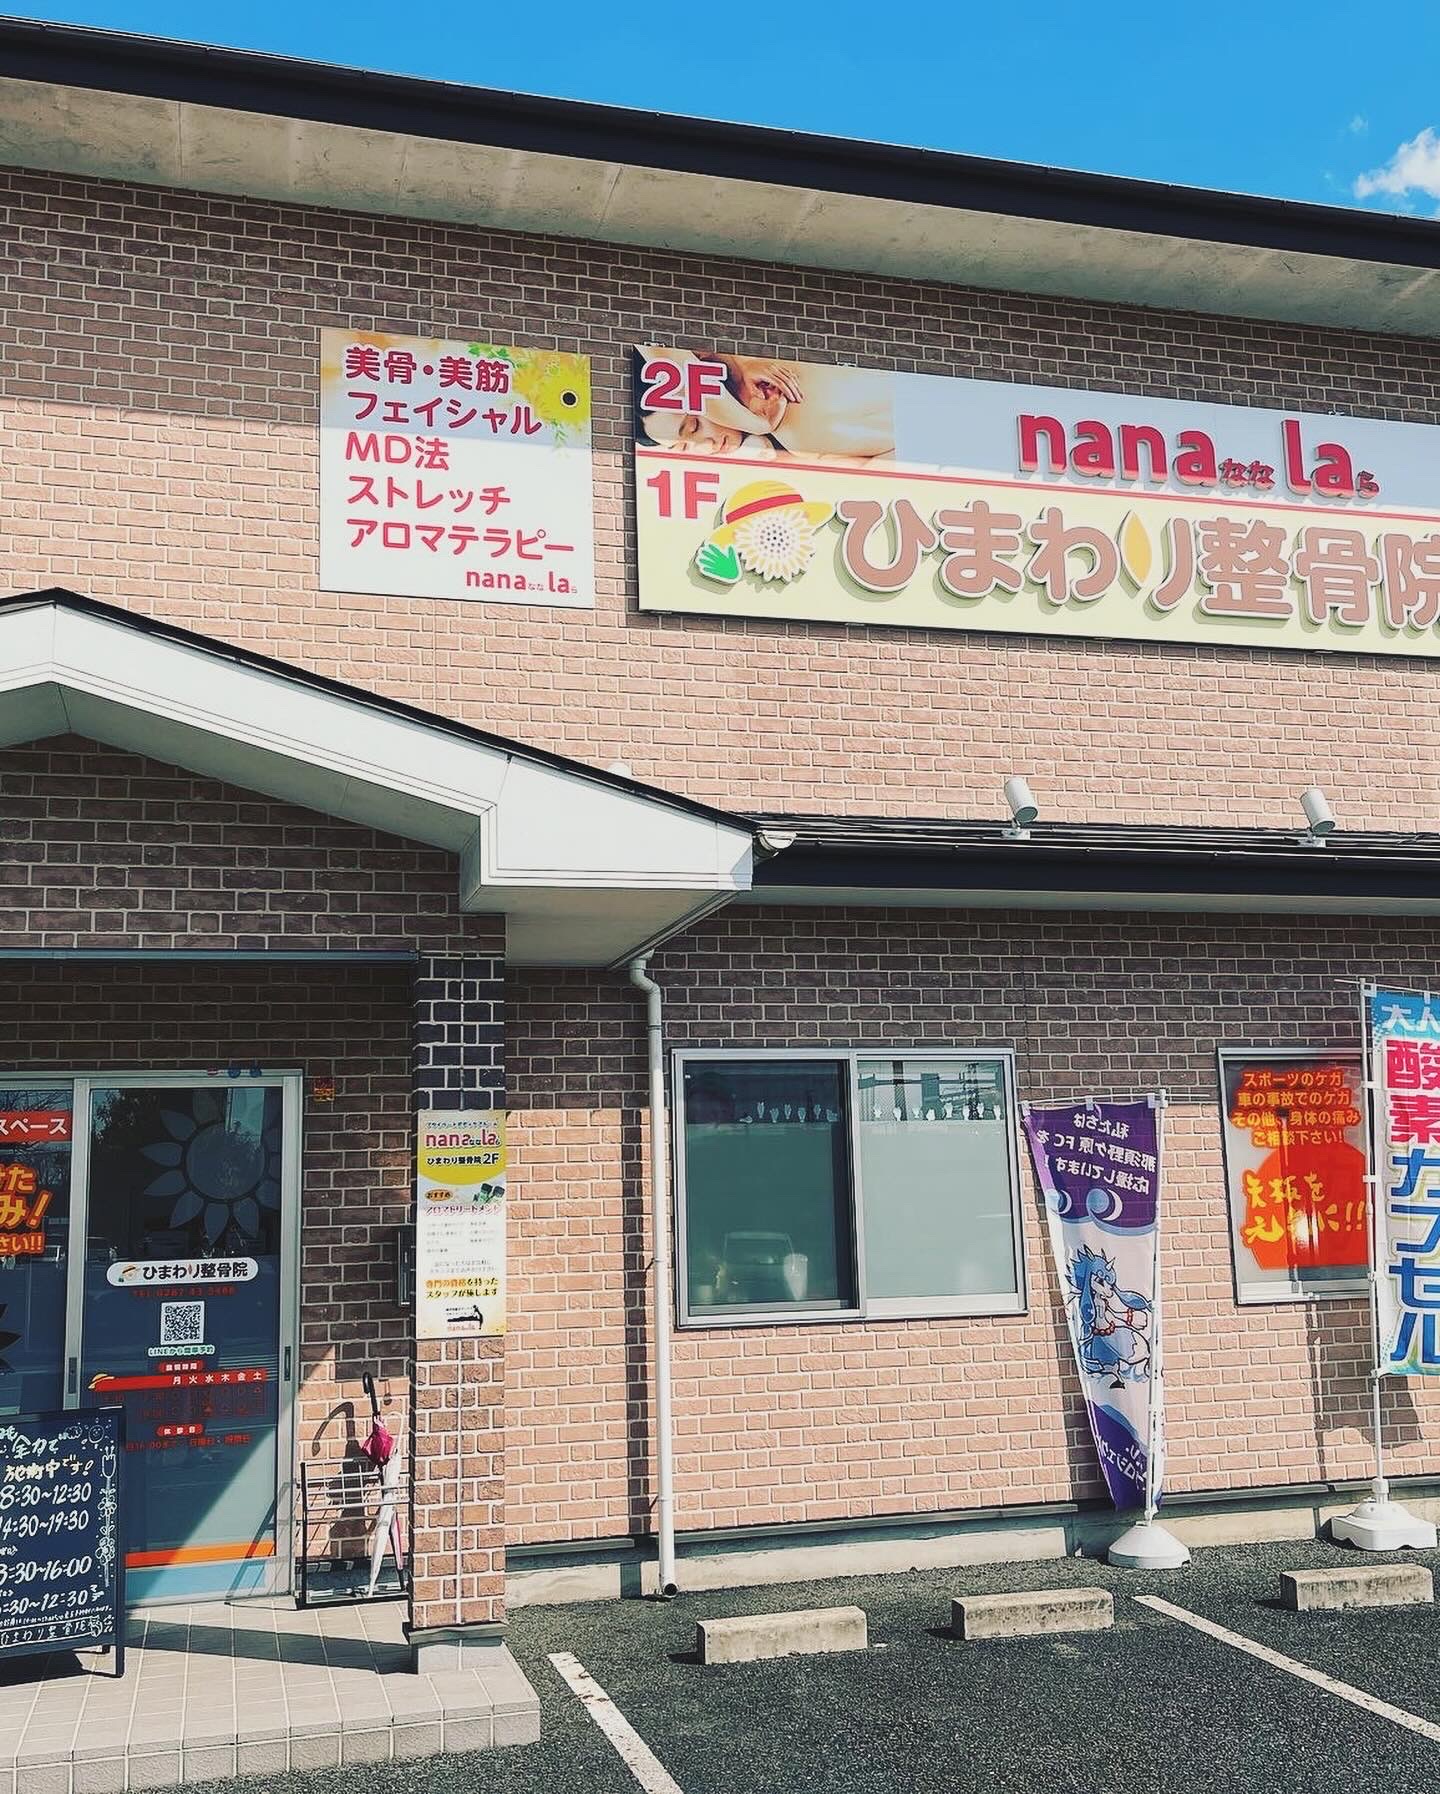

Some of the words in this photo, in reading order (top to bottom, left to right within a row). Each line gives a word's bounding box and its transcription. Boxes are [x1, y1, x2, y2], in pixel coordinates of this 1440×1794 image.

[345, 347, 509, 394] 美骨・美筋
[640, 359, 728, 414] 2F
[347, 391, 543, 435] フェイシャル
[345, 431, 450, 471] MD法
[1017, 413, 1217, 488] nana
[1281, 418, 1356, 499] la
[347, 475, 512, 516] ストレッチ
[646, 469, 720, 520] 1F
[346, 518, 575, 561] アロマテラピー
[466, 571, 527, 591] nana
[548, 571, 571, 594] la
[1237, 1091, 1351, 1107] 車の事故でのケガ
[1244, 1072, 1344, 1088] スポーツのケガ
[142, 1261, 249, 1280] ひまわり整骨院
